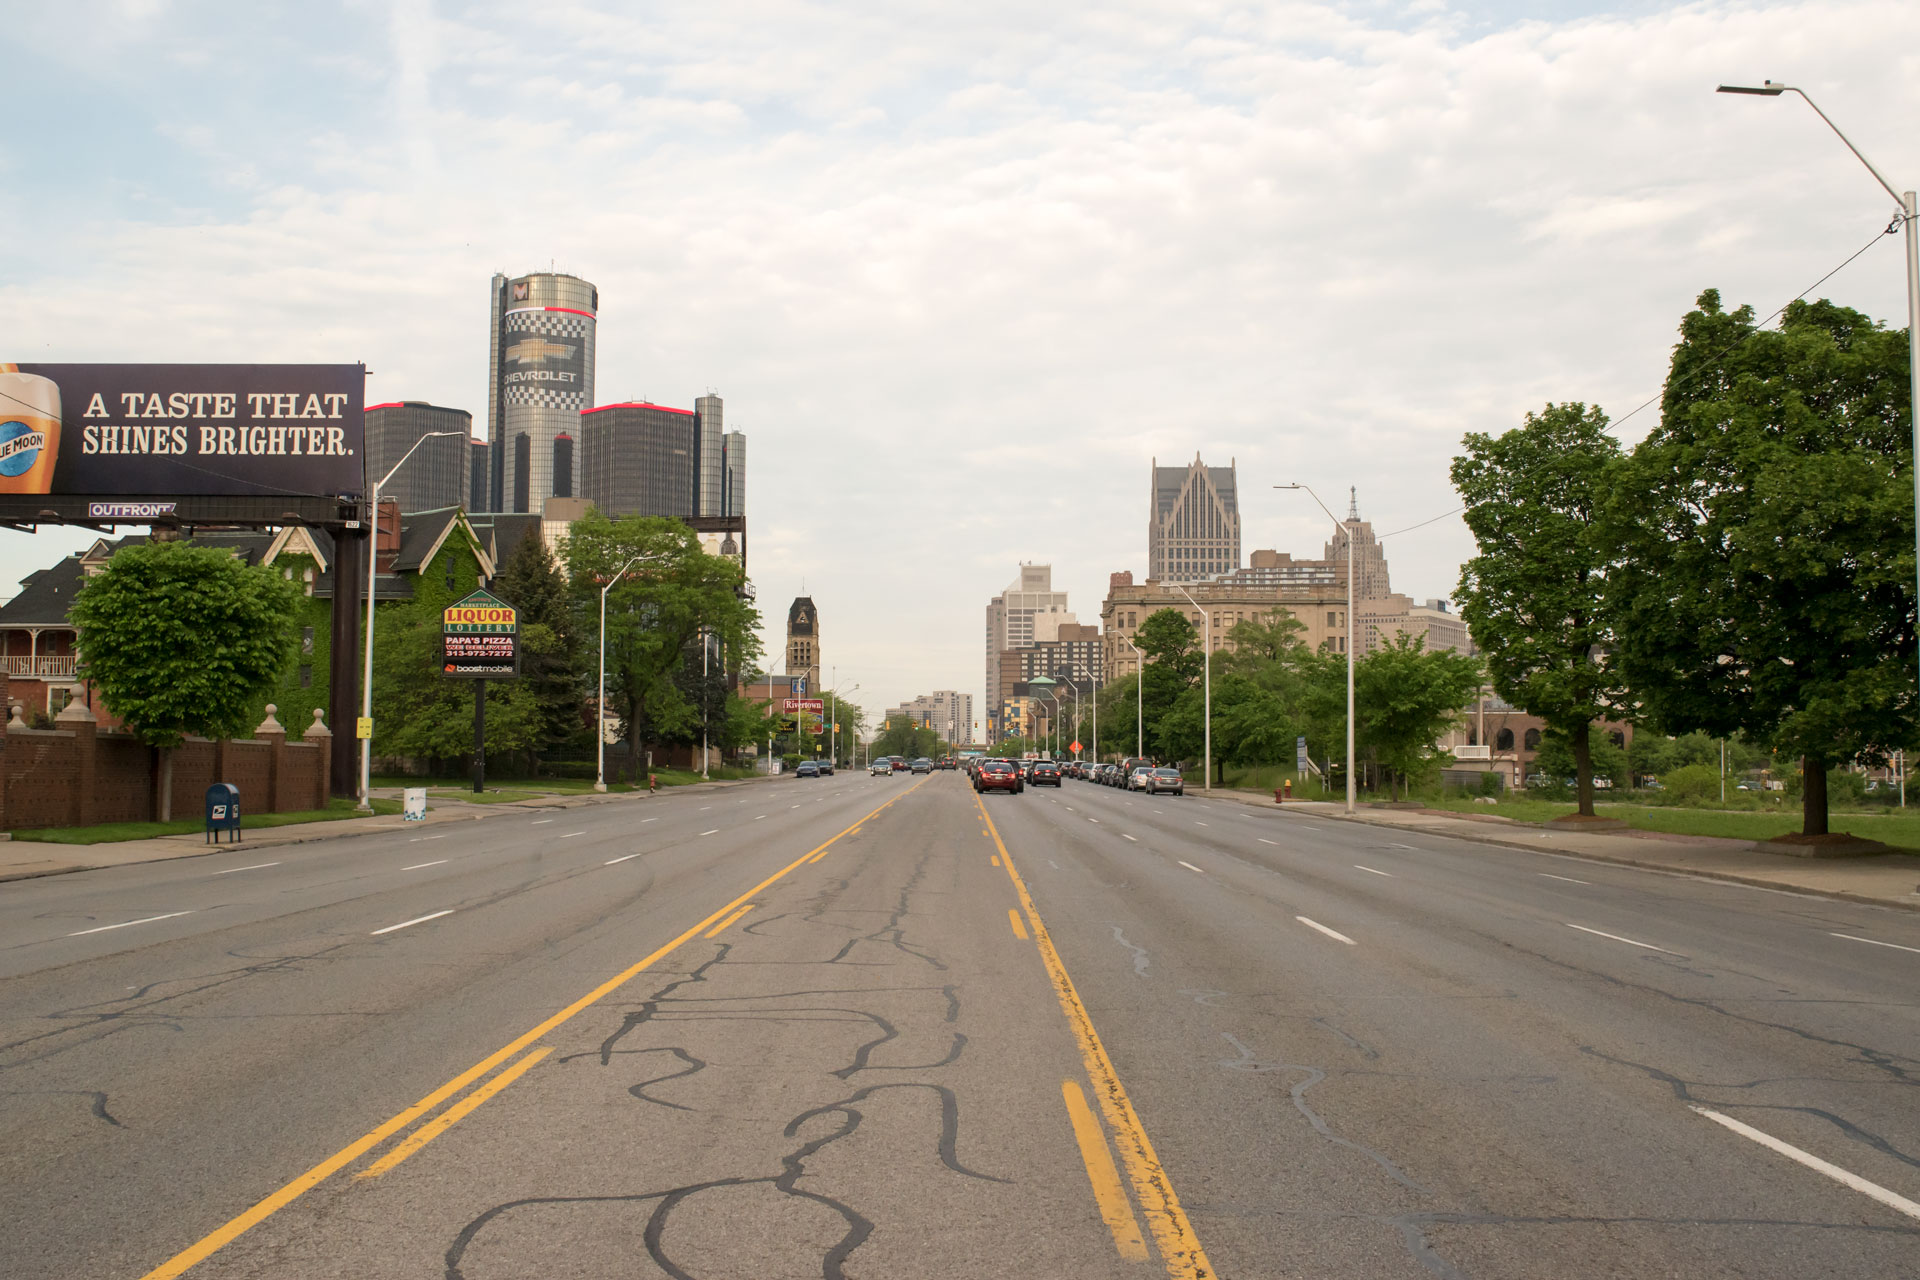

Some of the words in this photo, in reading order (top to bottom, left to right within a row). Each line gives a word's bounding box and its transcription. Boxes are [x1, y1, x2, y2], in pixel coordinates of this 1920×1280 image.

[504, 371, 576, 384] CHEVROLET
[83, 392, 110, 418] A
[121, 392, 237, 418] TASTE
[247, 393, 348, 418] THAT
[13, 434, 44, 453] MOON
[83, 426, 188, 455] SHINES
[199, 426, 354, 456] BRIGHTER.
[92, 504, 170, 516] OUTFRONT
[447, 610, 513, 623] LIQUOR
[786, 700, 821, 709] Rivertown
